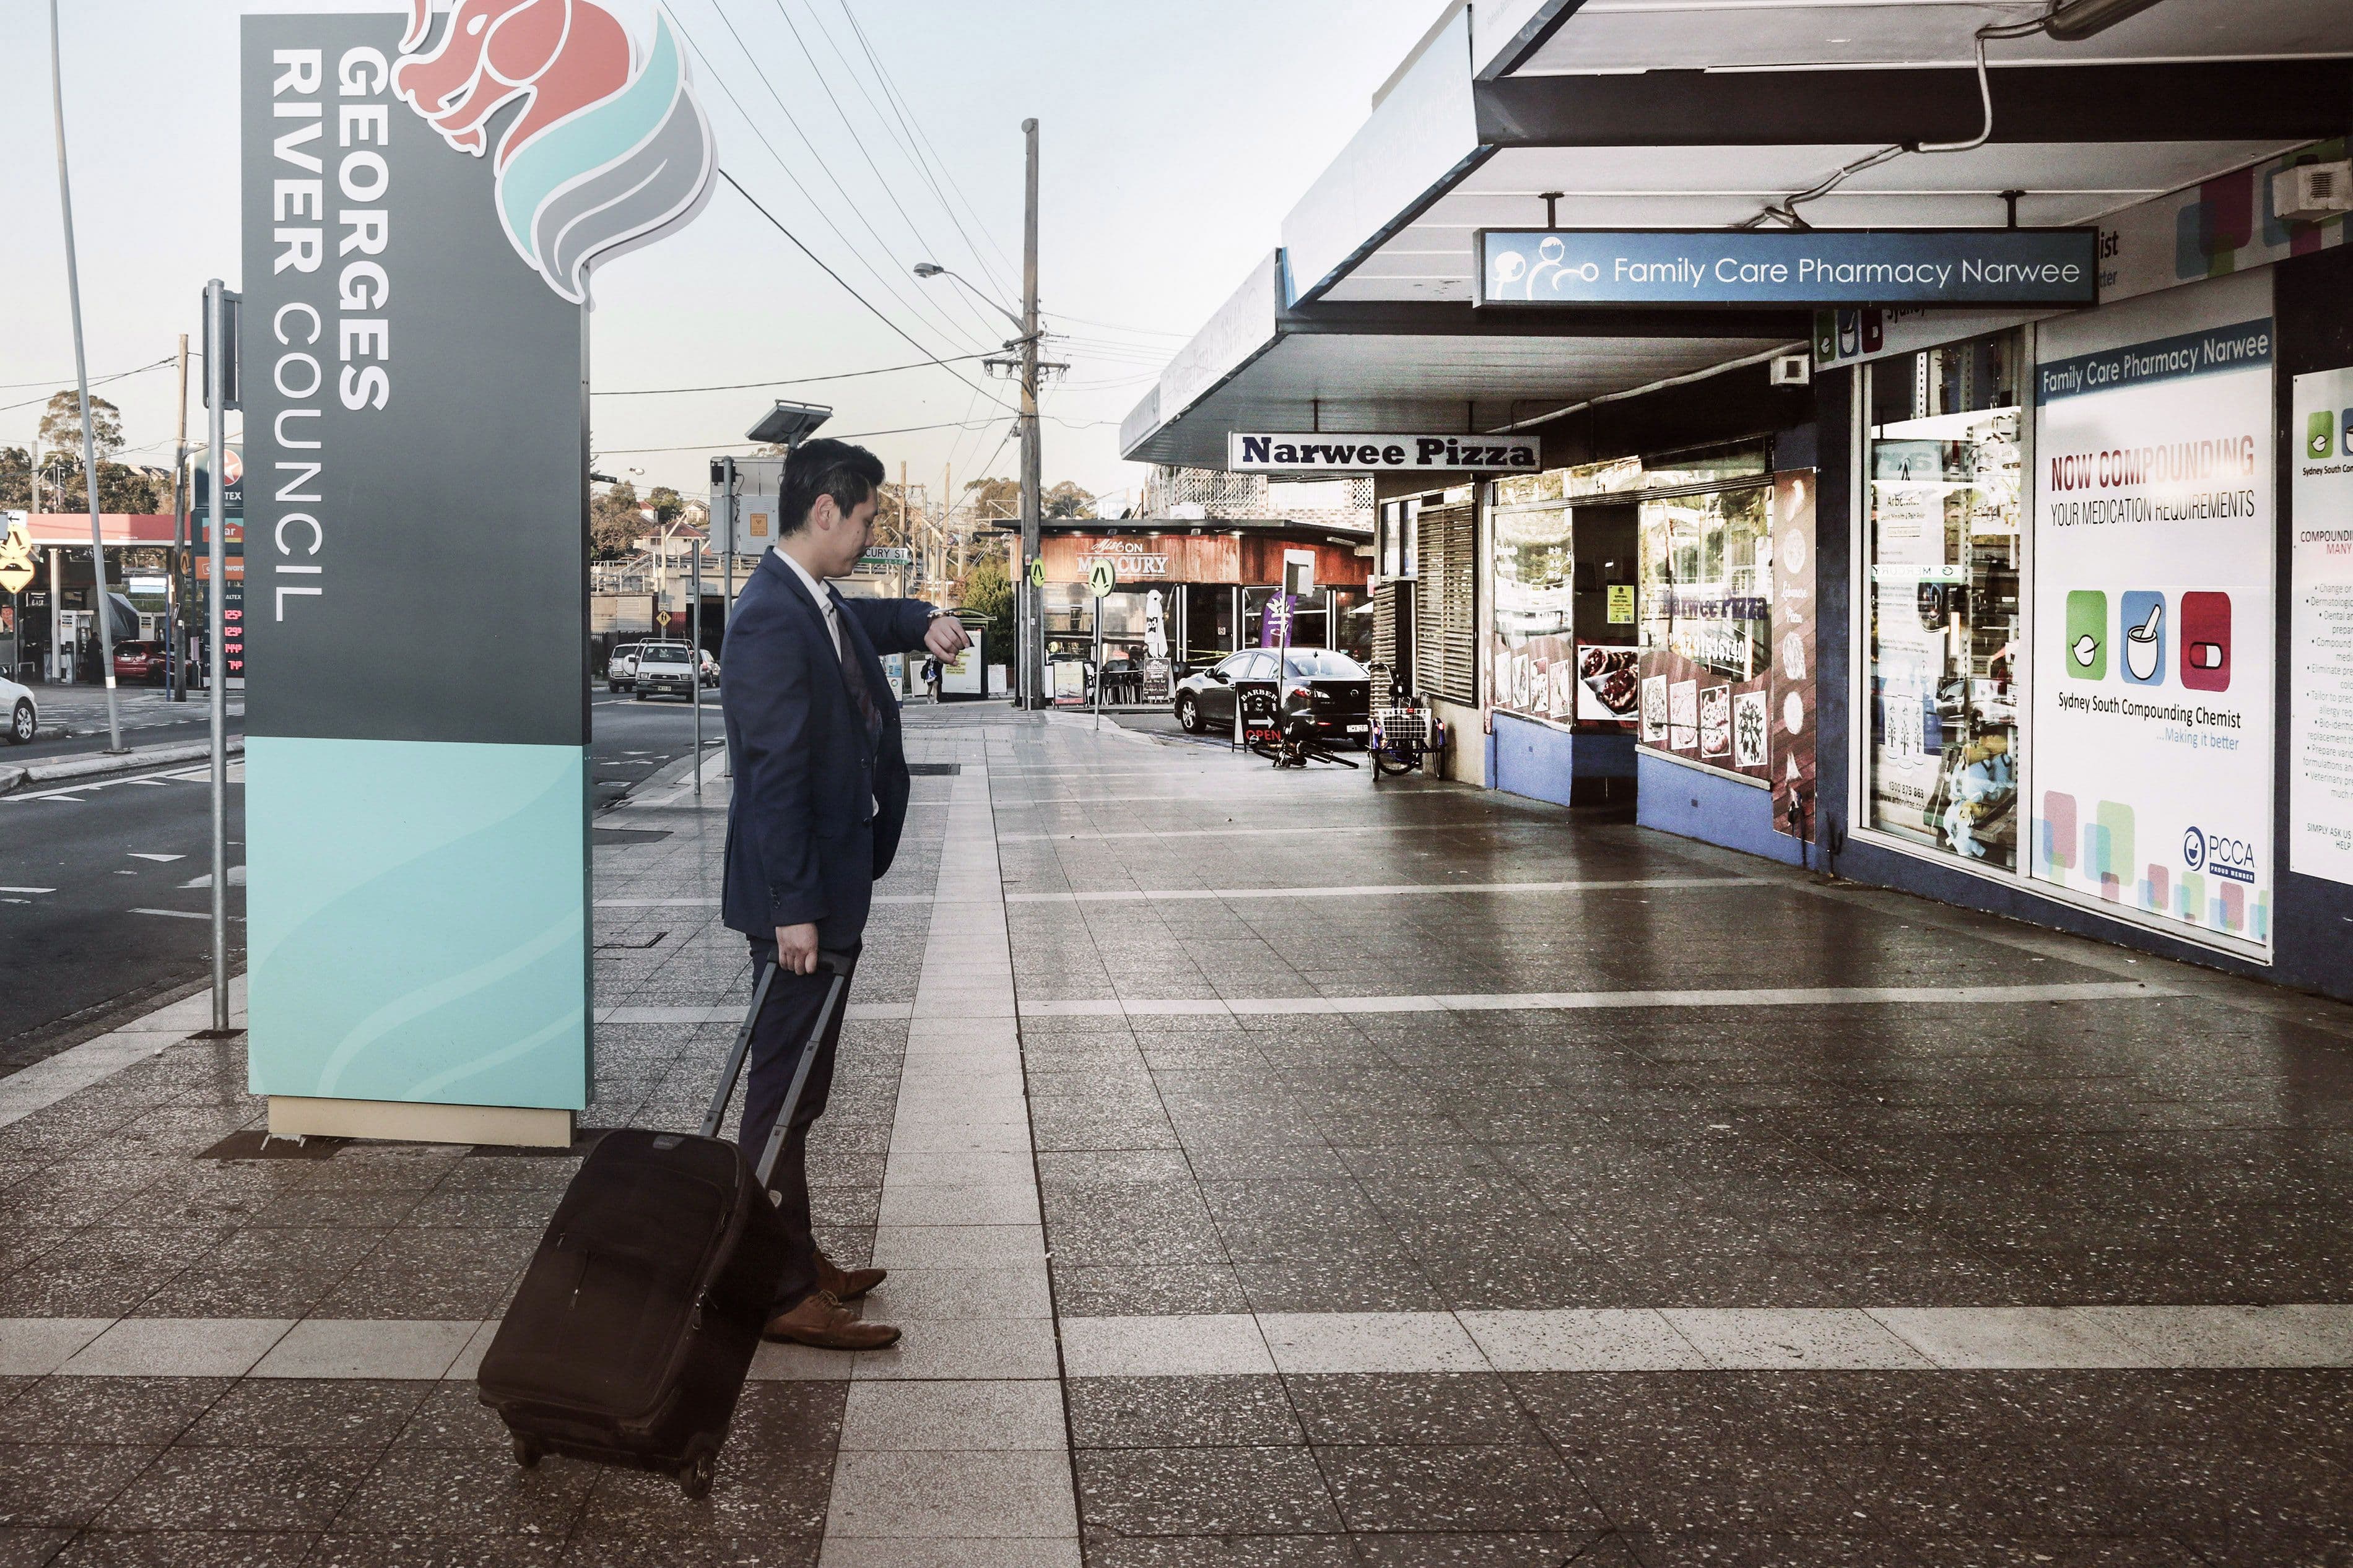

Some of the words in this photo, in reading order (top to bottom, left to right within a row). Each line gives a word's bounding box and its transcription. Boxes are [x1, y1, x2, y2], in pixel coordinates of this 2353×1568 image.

[273, 48, 323, 276] RIVER
[338, 46, 389, 411] GEORGES
[1614, 257, 1706, 288] Family
[1715, 258, 1788, 284] Care
[1798, 258, 1952, 289] Pharmacy
[1962, 258, 2081, 283] Narwee
[2043, 365, 2083, 393] Family
[2086, 361, 2120, 385] Care
[2124, 346, 2199, 379] Pharmacy
[2203, 333, 2269, 365] Narwee
[1242, 436, 1406, 464] Narwee
[1416, 438, 1536, 466] Pizza
[273, 301, 323, 622] COUNCIL
[2051, 453, 2093, 492] NOW
[2099, 435, 2255, 488] COMPOUNDING
[2302, 467, 2323, 477] Sydney
[2324, 465, 2341, 474] South
[224, 491, 242, 501] TEX
[2051, 502, 2079, 527] YOUR
[2082, 497, 2152, 525] MEDICATION
[2155, 489, 2255, 521] REQUIREMENTS
[2300, 530, 2353, 542] COMPOUNDI
[865, 548, 890, 558] CURY
[894, 550, 906, 558] ST
[1124, 543, 1143, 553] ON
[2326, 544, 2352, 555] MANY
[1077, 556, 1169, 574] MCURY
[1781, 581, 1809, 601] Lebanese
[2320, 583, 2339, 596] Change
[1721, 588, 1768, 620] Pizza
[2324, 610, 2344, 620] Dental
[2316, 637, 2352, 649] Compound
[2312, 663, 2341, 675] Eliminate
[1240, 688, 1278, 702] BARBER
[2329, 693, 2336, 701] to
[2058, 691, 2090, 714] Sydney
[2092, 695, 2120, 714] South
[2122, 698, 2193, 727] Compounding
[2196, 706, 2241, 729] Chemist
[1245, 729, 1281, 741] OPEN
[2201, 731, 2208, 747] it
[2210, 734, 2240, 751] better
[2308, 731, 2347, 744] replacement
[2312, 743, 2336, 757] Prepare
[2303, 755, 2343, 771] formulations
[2310, 771, 2343, 787] Veterinary
[2307, 823, 2328, 835] SIMPLY
[2329, 827, 2342, 838] ASK
[2342, 829, 2352, 839] US
[2209, 834, 2255, 868] PCCA
[2336, 840, 2351, 851] HELP
[2210, 865, 2229, 875] PROUD
[2230, 870, 2254, 881] MEMBER
